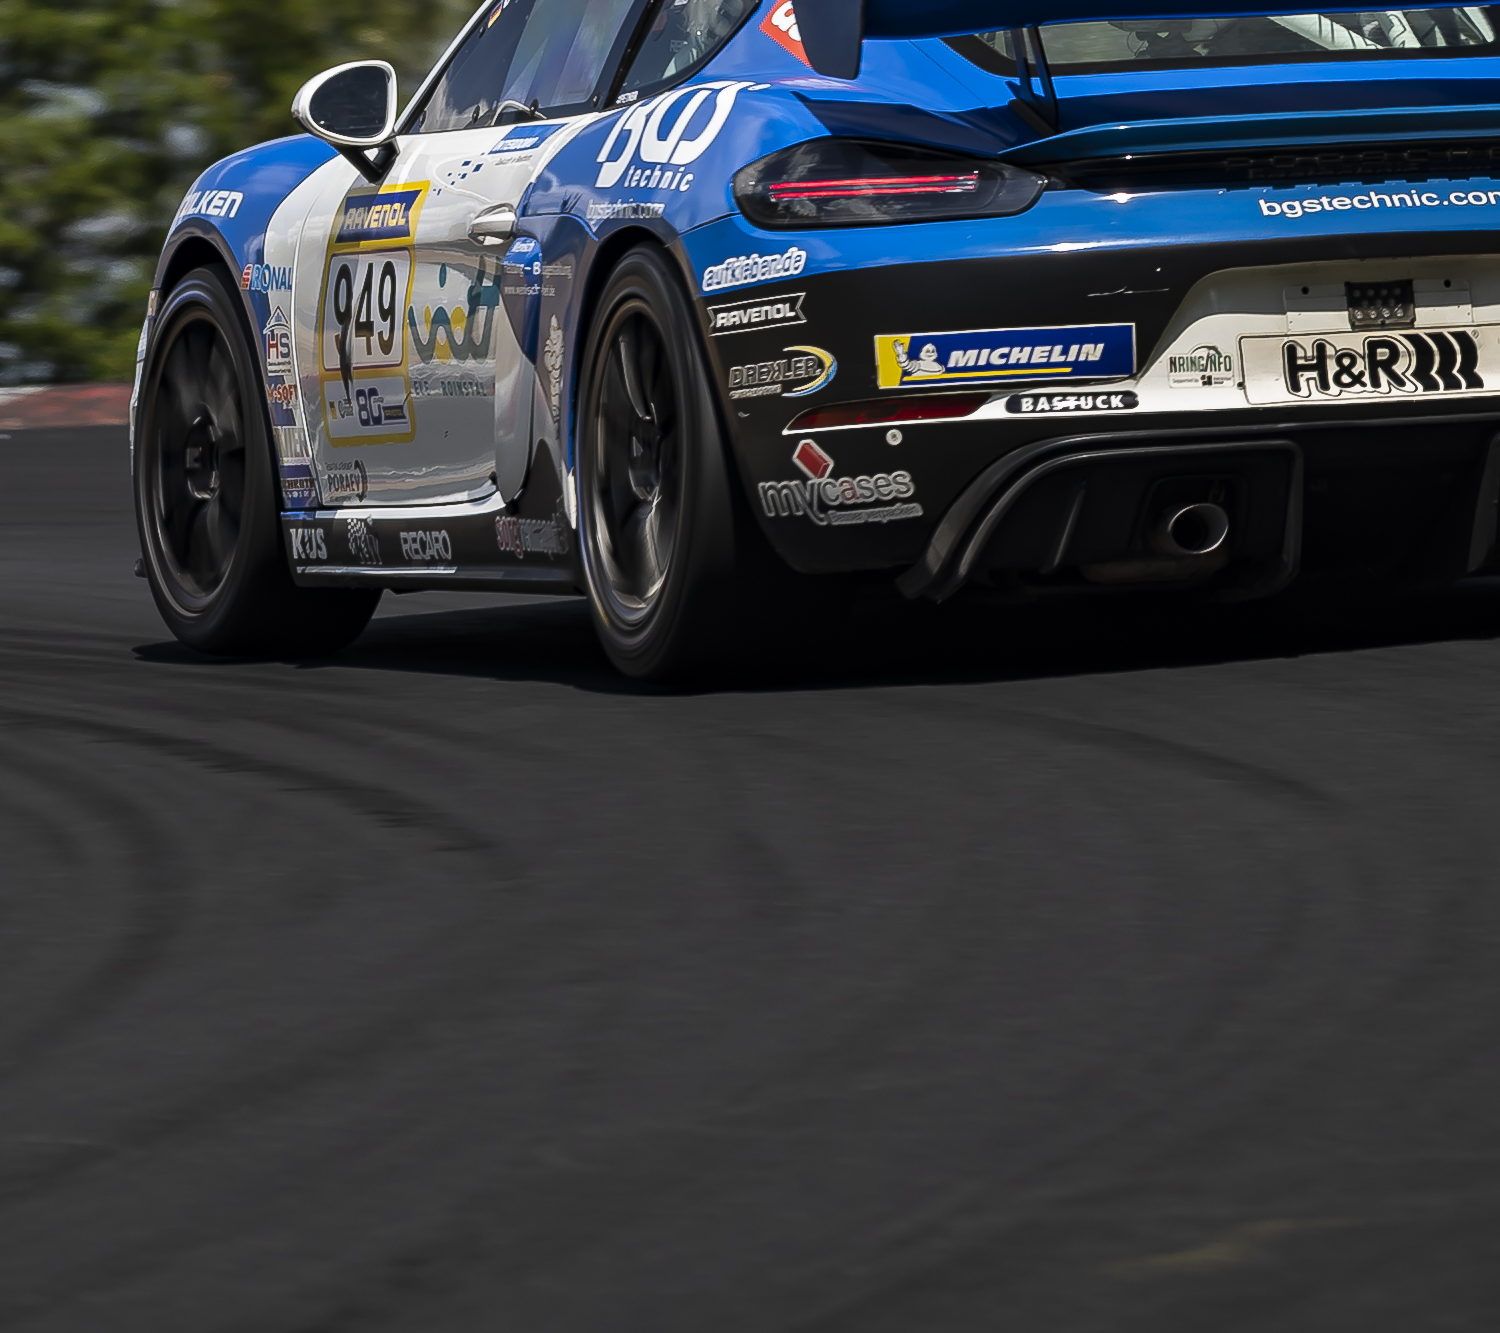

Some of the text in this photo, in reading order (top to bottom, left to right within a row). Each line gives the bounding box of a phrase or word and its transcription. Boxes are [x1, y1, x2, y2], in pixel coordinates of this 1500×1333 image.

[623, 164, 695, 192] technic
[343, 202, 406, 230] RAVENOL
[251, 264, 293, 293] RONAL
[333, 260, 397, 356] 949
[716, 303, 796, 327] RAVENOL
[267, 333, 291, 360] HS
[946, 343, 1105, 368] MICHELIN
[729, 355, 820, 387] DREXLER
[1284, 338, 1407, 394] H&R
[1021, 395, 1124, 412] BASTUCK
[758, 470, 915, 526] mycases
[400, 529, 451, 561] RECARO
